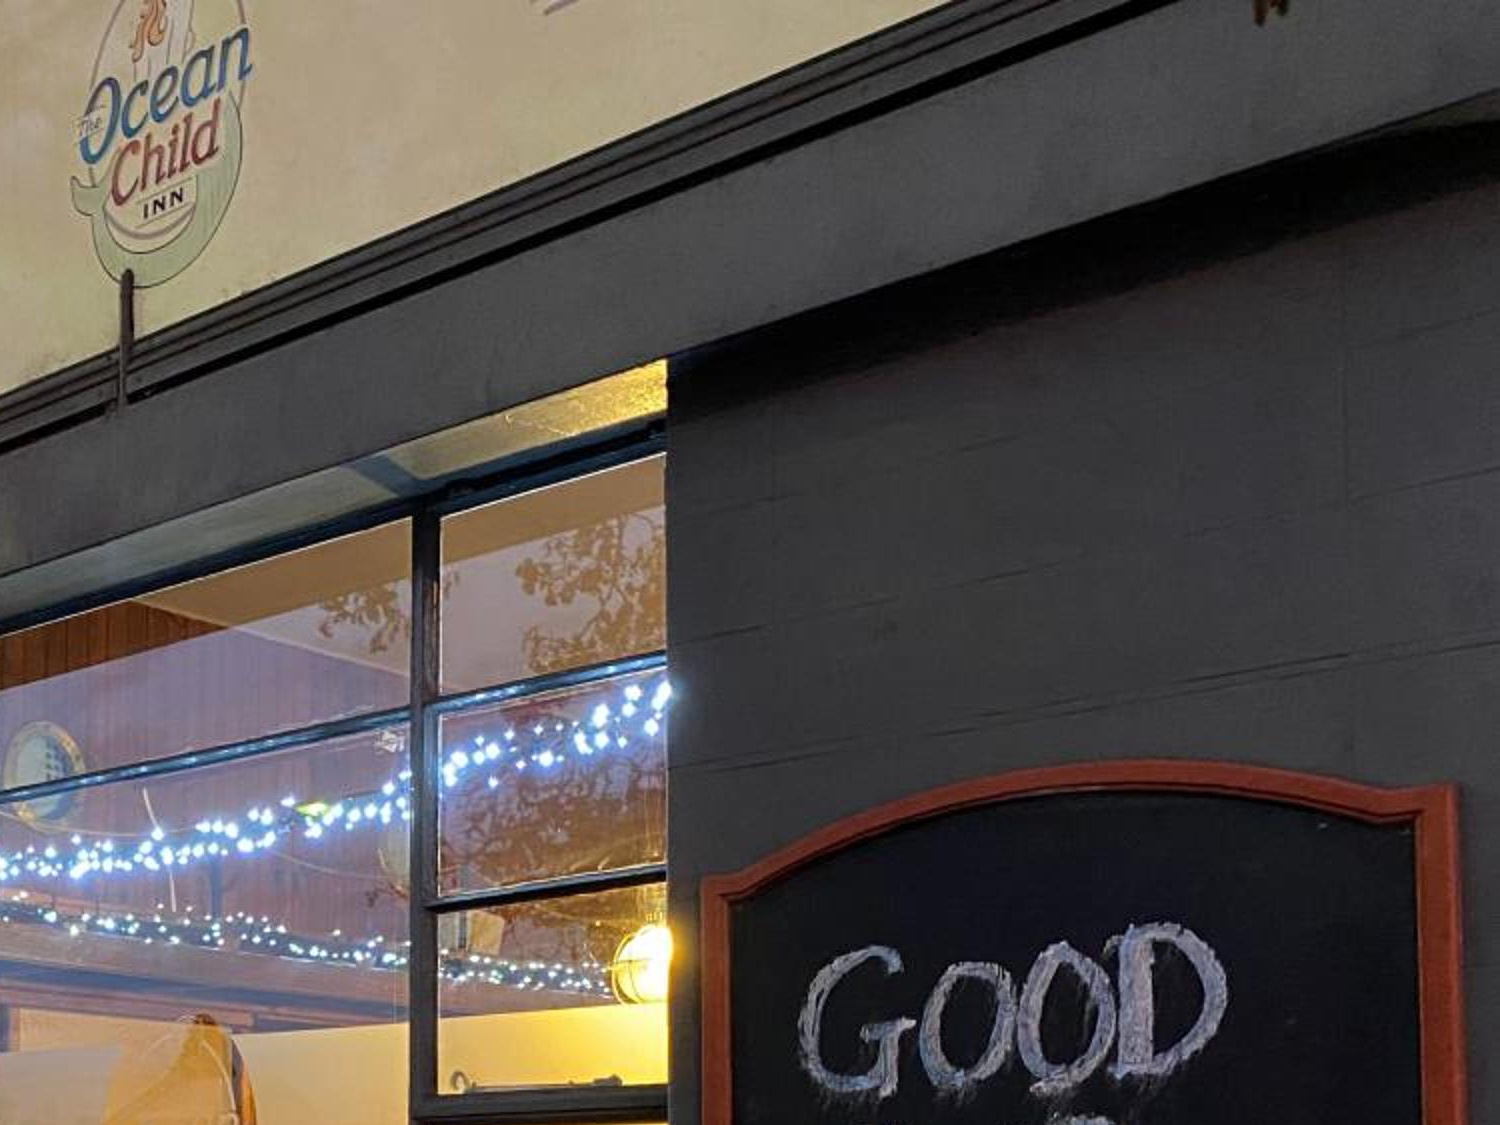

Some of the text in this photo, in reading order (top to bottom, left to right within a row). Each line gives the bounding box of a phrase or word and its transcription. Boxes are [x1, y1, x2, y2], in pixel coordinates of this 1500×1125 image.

[79, 27, 253, 165] Ocean
[111, 97, 220, 206] Child
[142, 187, 184, 219] INN
[797, 921, 1228, 1098] GOOD
